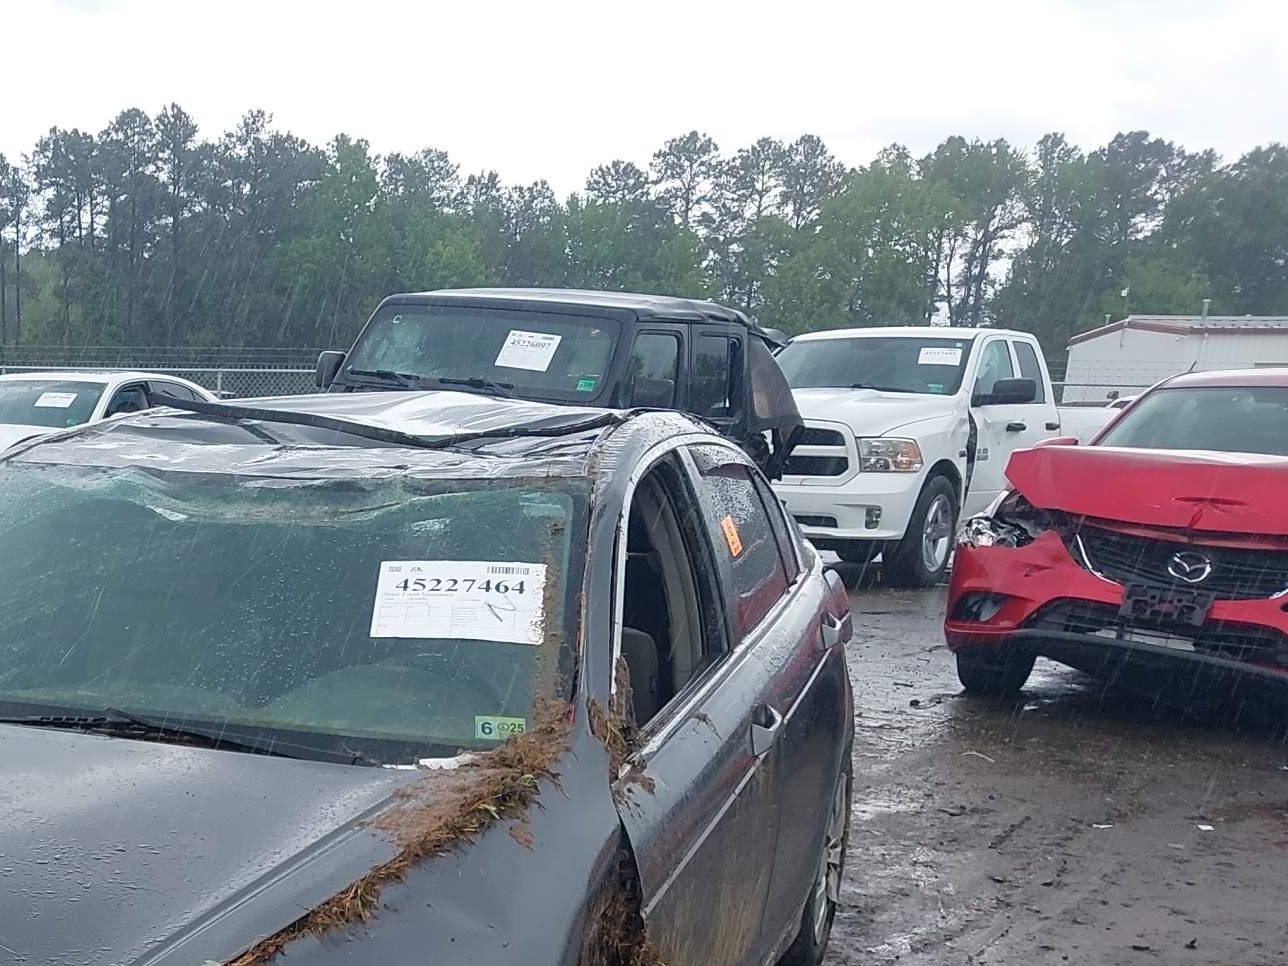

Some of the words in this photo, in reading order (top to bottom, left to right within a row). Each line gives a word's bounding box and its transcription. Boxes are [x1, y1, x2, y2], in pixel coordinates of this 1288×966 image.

[395, 577, 526, 595] 45227464
[481, 721, 493, 735] 6
[510, 722, 524, 734] 25
